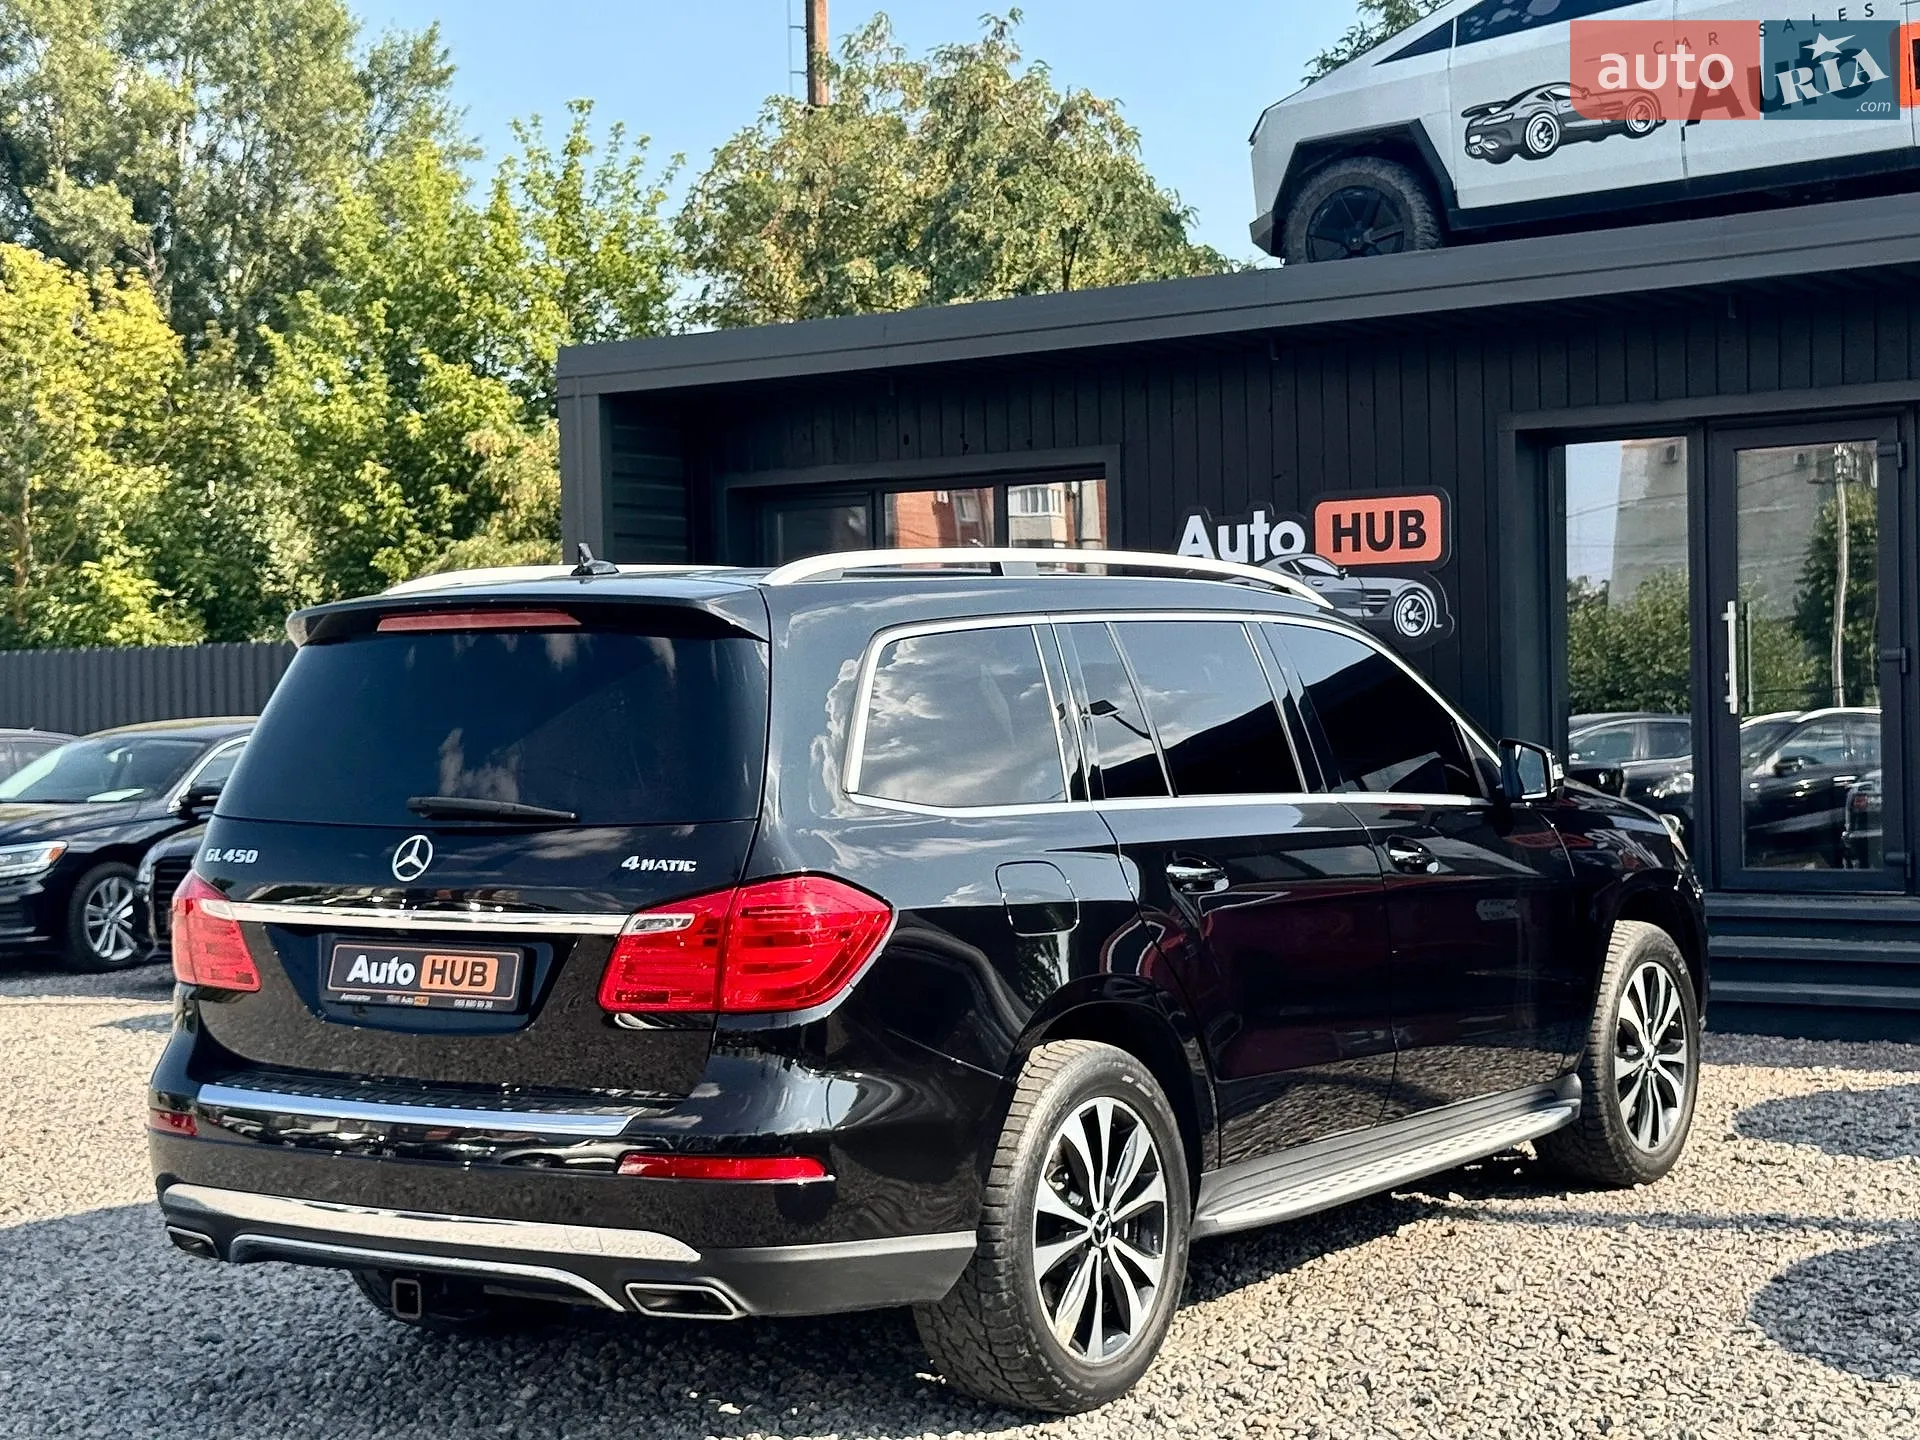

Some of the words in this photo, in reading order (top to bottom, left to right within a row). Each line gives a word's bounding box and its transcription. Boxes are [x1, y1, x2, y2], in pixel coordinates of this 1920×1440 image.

[1758, 2, 1875, 37] SALES
[1177, 510, 1306, 563] Auto
[1331, 509, 1427, 553] HUB
[621, 855, 698, 873] 4MATIC
[346, 954, 416, 987] Auto
[428, 958, 489, 987] HUB
